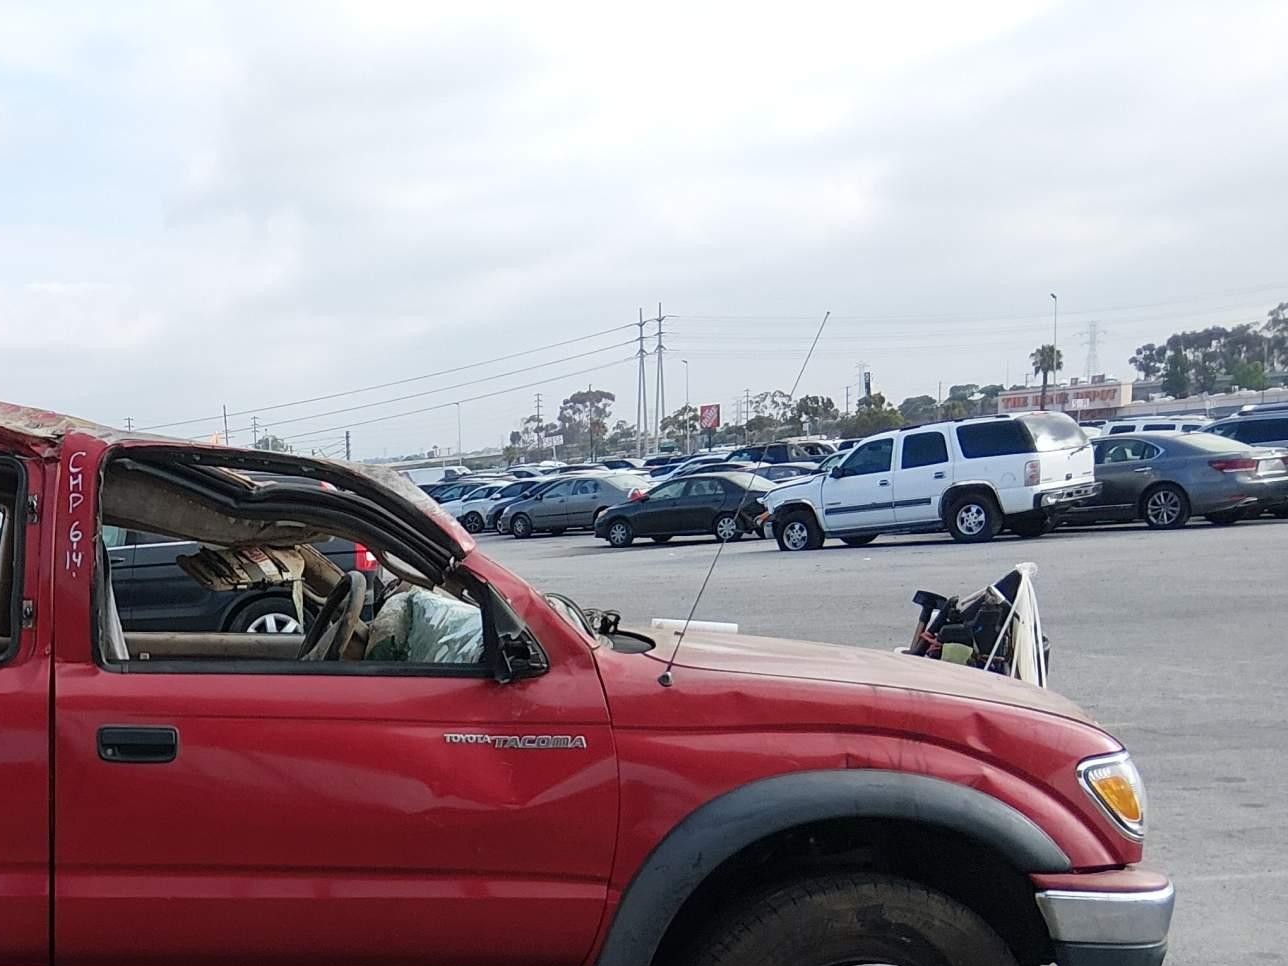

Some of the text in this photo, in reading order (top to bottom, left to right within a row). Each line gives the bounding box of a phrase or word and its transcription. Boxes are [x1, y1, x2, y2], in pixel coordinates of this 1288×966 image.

[68, 451, 87, 514] CHP
[443, 733, 588, 749] TOYOTA TACOMA
